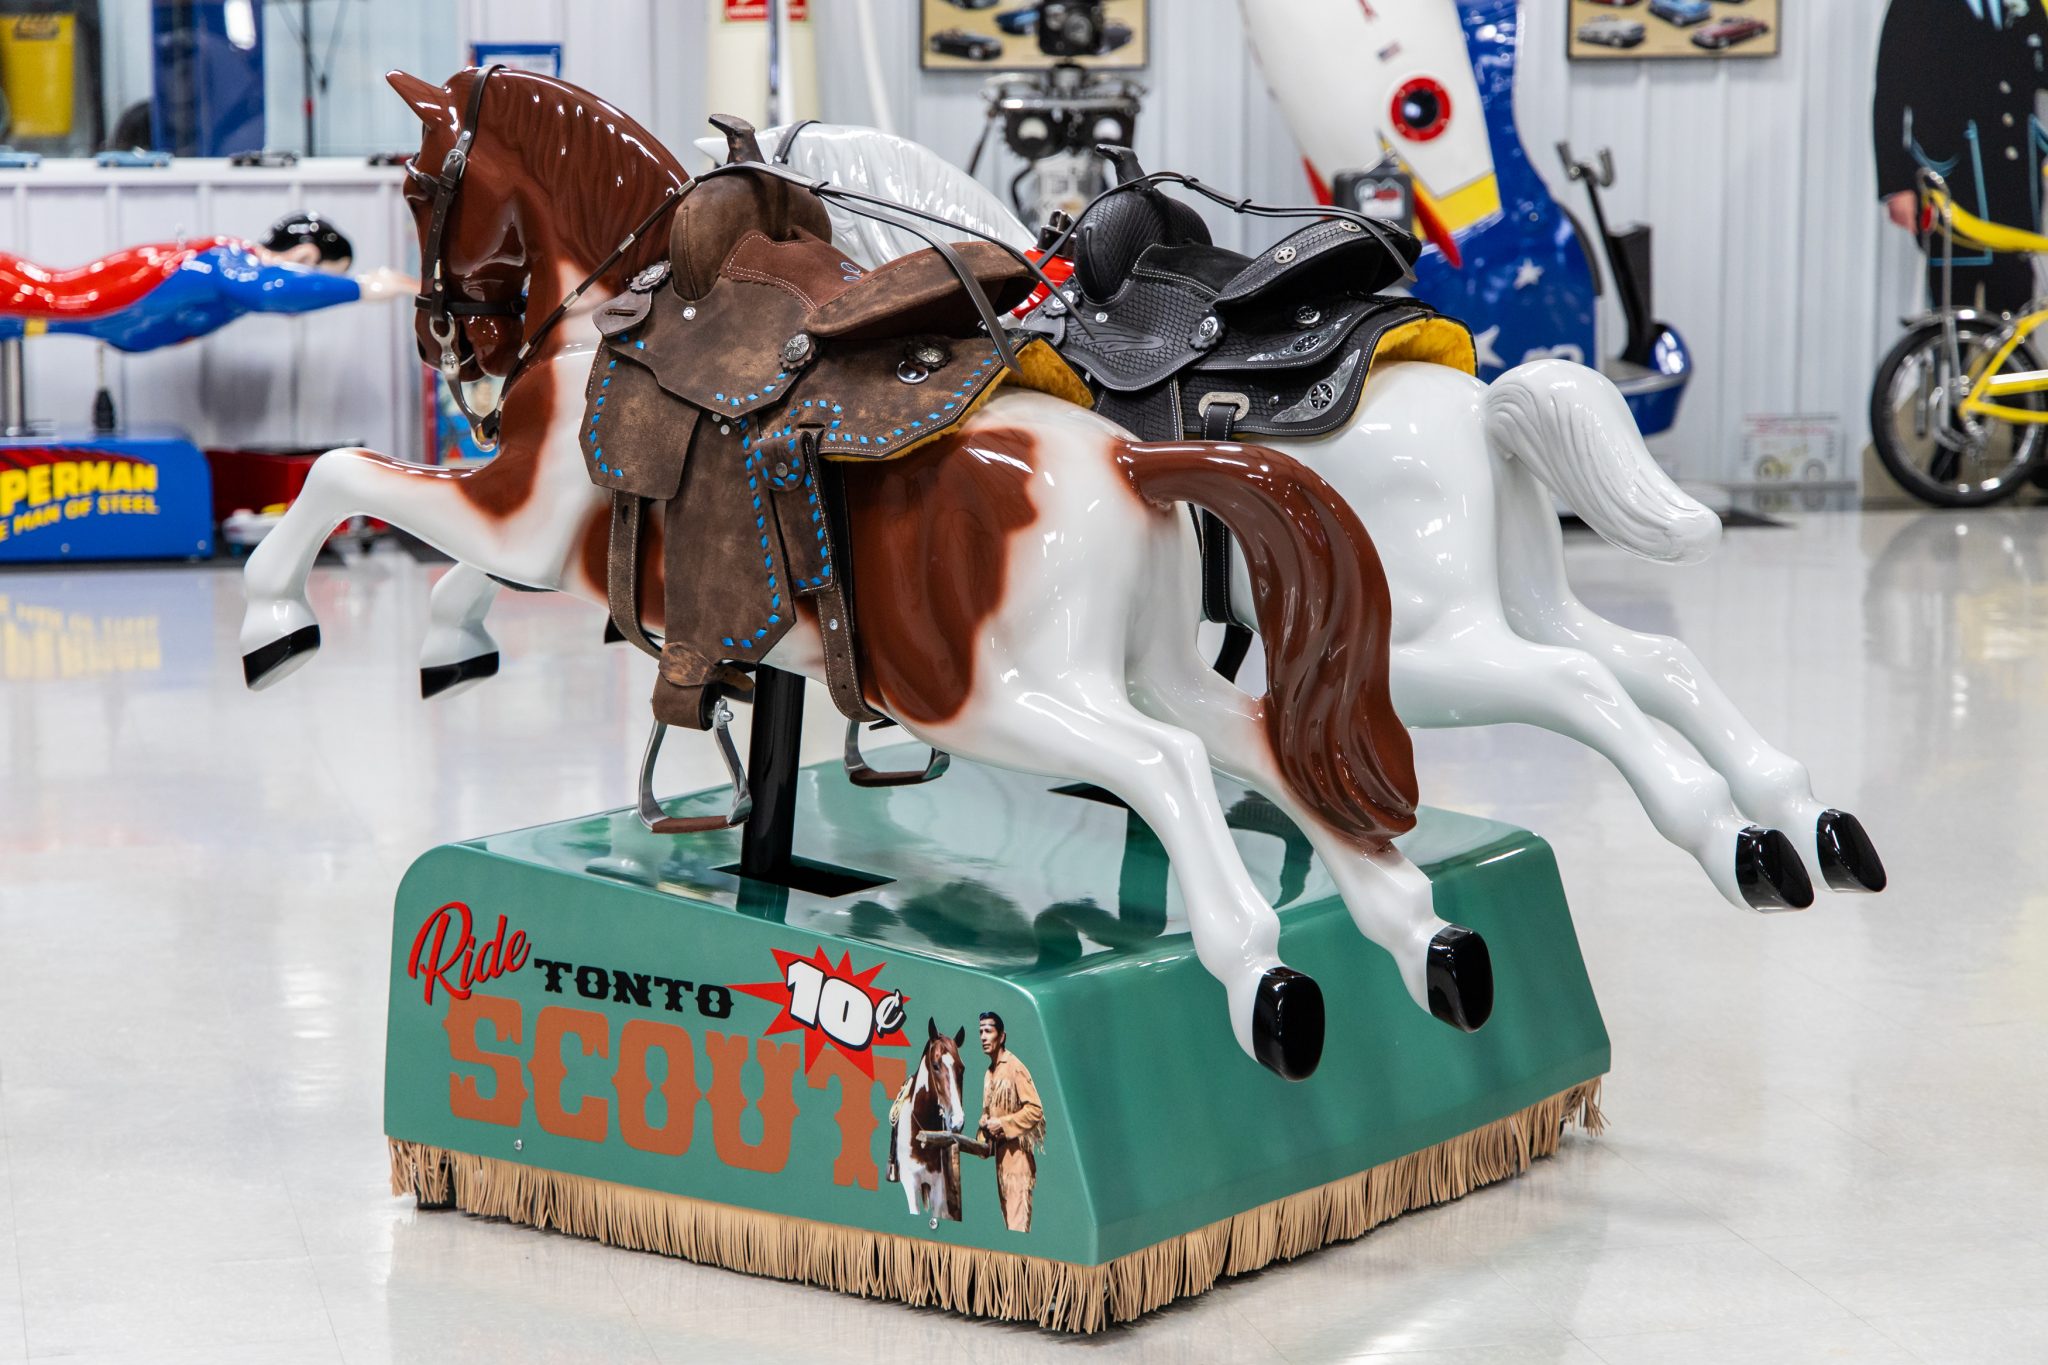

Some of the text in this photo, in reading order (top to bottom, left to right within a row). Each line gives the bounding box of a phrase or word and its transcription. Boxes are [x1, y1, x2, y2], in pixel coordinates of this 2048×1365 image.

[13, 504, 61, 535] MAN
[64, 497, 93, 519] OF
[97, 494, 160, 515] STEEL
[407, 901, 531, 1006] Ride
[534, 958, 734, 1019] TONTO
[786, 959, 907, 1051] 10¢
[442, 993, 907, 1191] SCOUT
